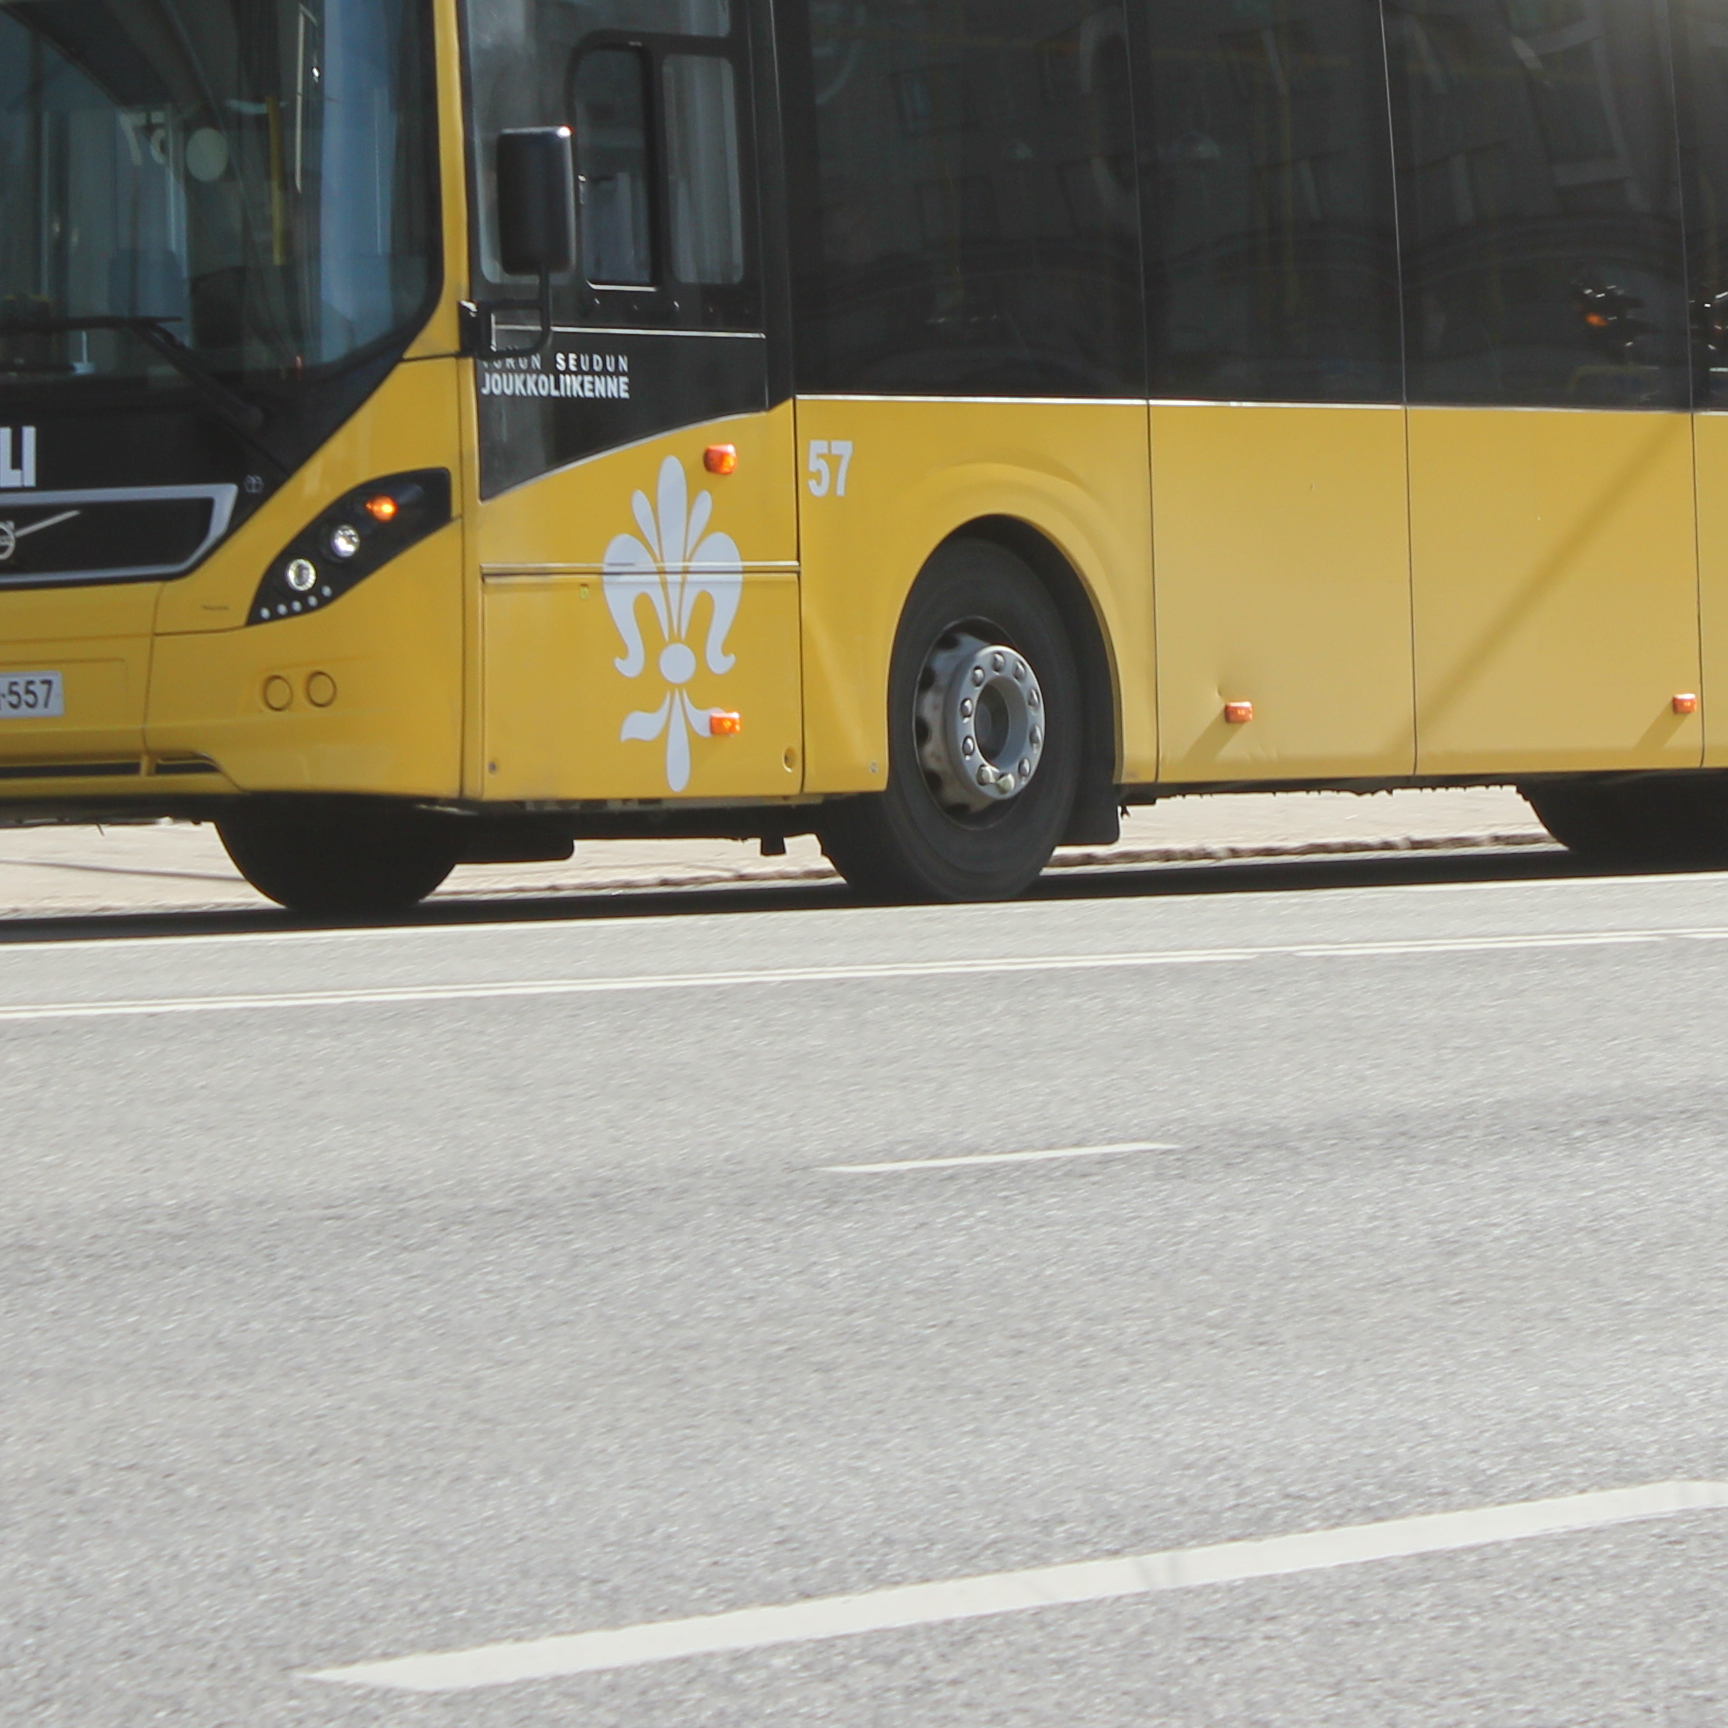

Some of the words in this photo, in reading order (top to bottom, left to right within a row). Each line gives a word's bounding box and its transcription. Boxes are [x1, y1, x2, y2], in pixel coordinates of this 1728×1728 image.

[555, 352, 629, 372] SEUDUN
[480, 372, 630, 399] JOUKKOLIIKENNE
[807, 439, 854, 498] 57
